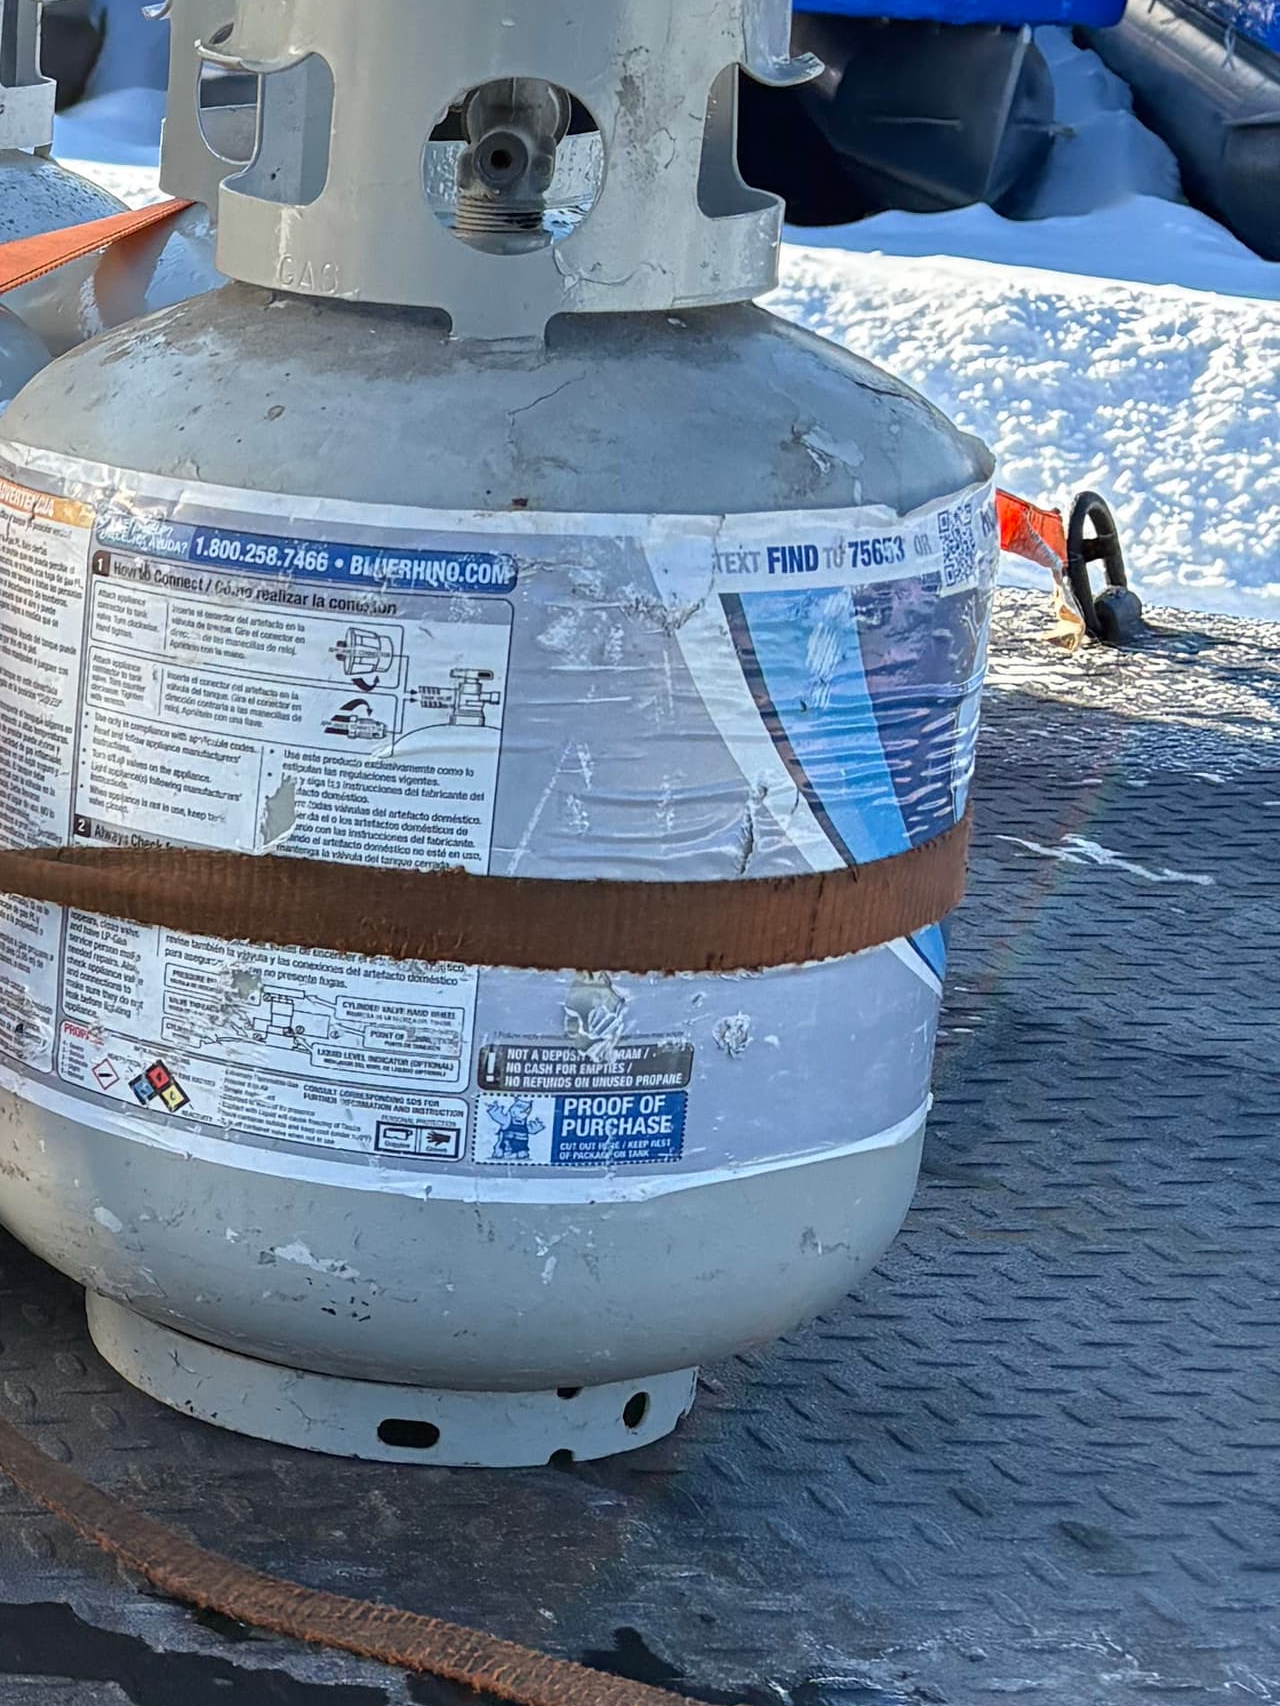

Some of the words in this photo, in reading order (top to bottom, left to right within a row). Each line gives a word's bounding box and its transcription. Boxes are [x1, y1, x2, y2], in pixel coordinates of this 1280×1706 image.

[196, 536, 329, 572] 1.800.258.7466
[349, 555, 510, 585] BLUERHINO.COM
[714, 552, 760, 574] TEXT
[767, 544, 819, 574] FIND
[848, 537, 904, 569] 75653
[914, 534, 932, 557] OR
[98, 559, 103, 571] 1
[154, 569, 203, 591] Connect
[256, 589, 307, 607] realizar
[312, 594, 325, 608] la
[78, 820, 86, 832] 2
[507, 1049, 527, 1060] NOT
[530, 1049, 539, 1060] A
[506, 1063, 521, 1074] NO
[524, 1062, 553, 1075] CASH
[555, 1063, 577, 1075] FOR
[579, 1062, 625, 1074] EMPTIES
[505, 1076, 520, 1087] NO
[523, 1076, 572, 1088] REFUNDS
[575, 1076, 590, 1088] ON
[592, 1076, 633, 1087] UNUSED
[635, 1073, 682, 1086] PROPANE
[424, 1099, 439, 1107] FOR
[564, 1096, 635, 1116] PROOF
[640, 1095, 667, 1114] OF
[561, 1116, 673, 1137] PURCHASE
[560, 1143, 577, 1151] CUT
